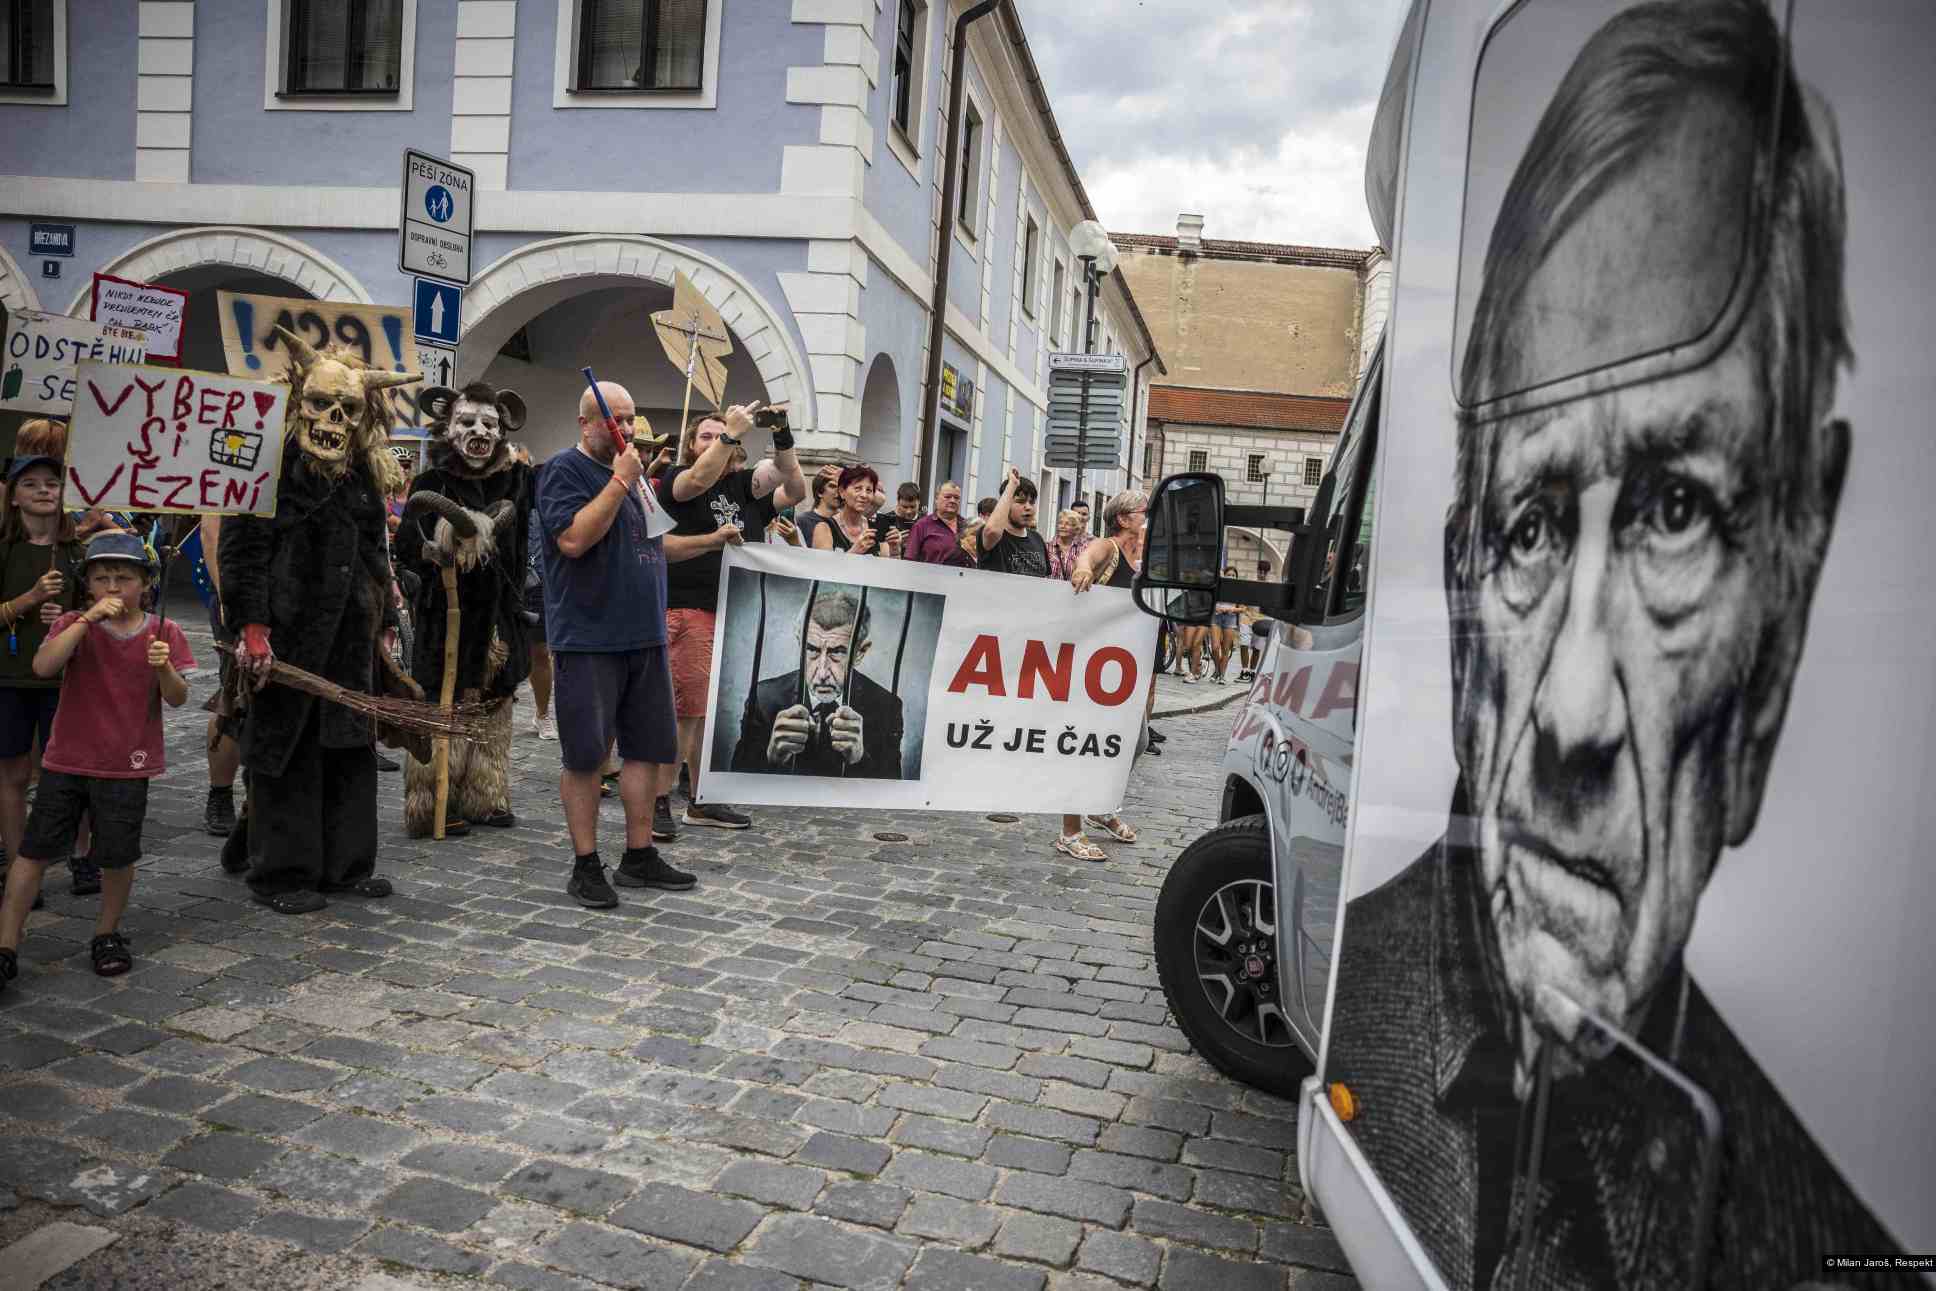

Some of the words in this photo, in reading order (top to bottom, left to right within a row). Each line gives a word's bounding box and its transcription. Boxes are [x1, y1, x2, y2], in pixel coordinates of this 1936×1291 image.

[411, 161, 437, 182] PĚŠÍ
[439, 170, 468, 193] ZÓNA
[38, 375, 77, 402] SE
[947, 633, 1138, 707] ANO
[946, 718, 994, 750] UŽ
[1003, 727, 1047, 754] JE
[1056, 725, 1122, 758] ČAS
